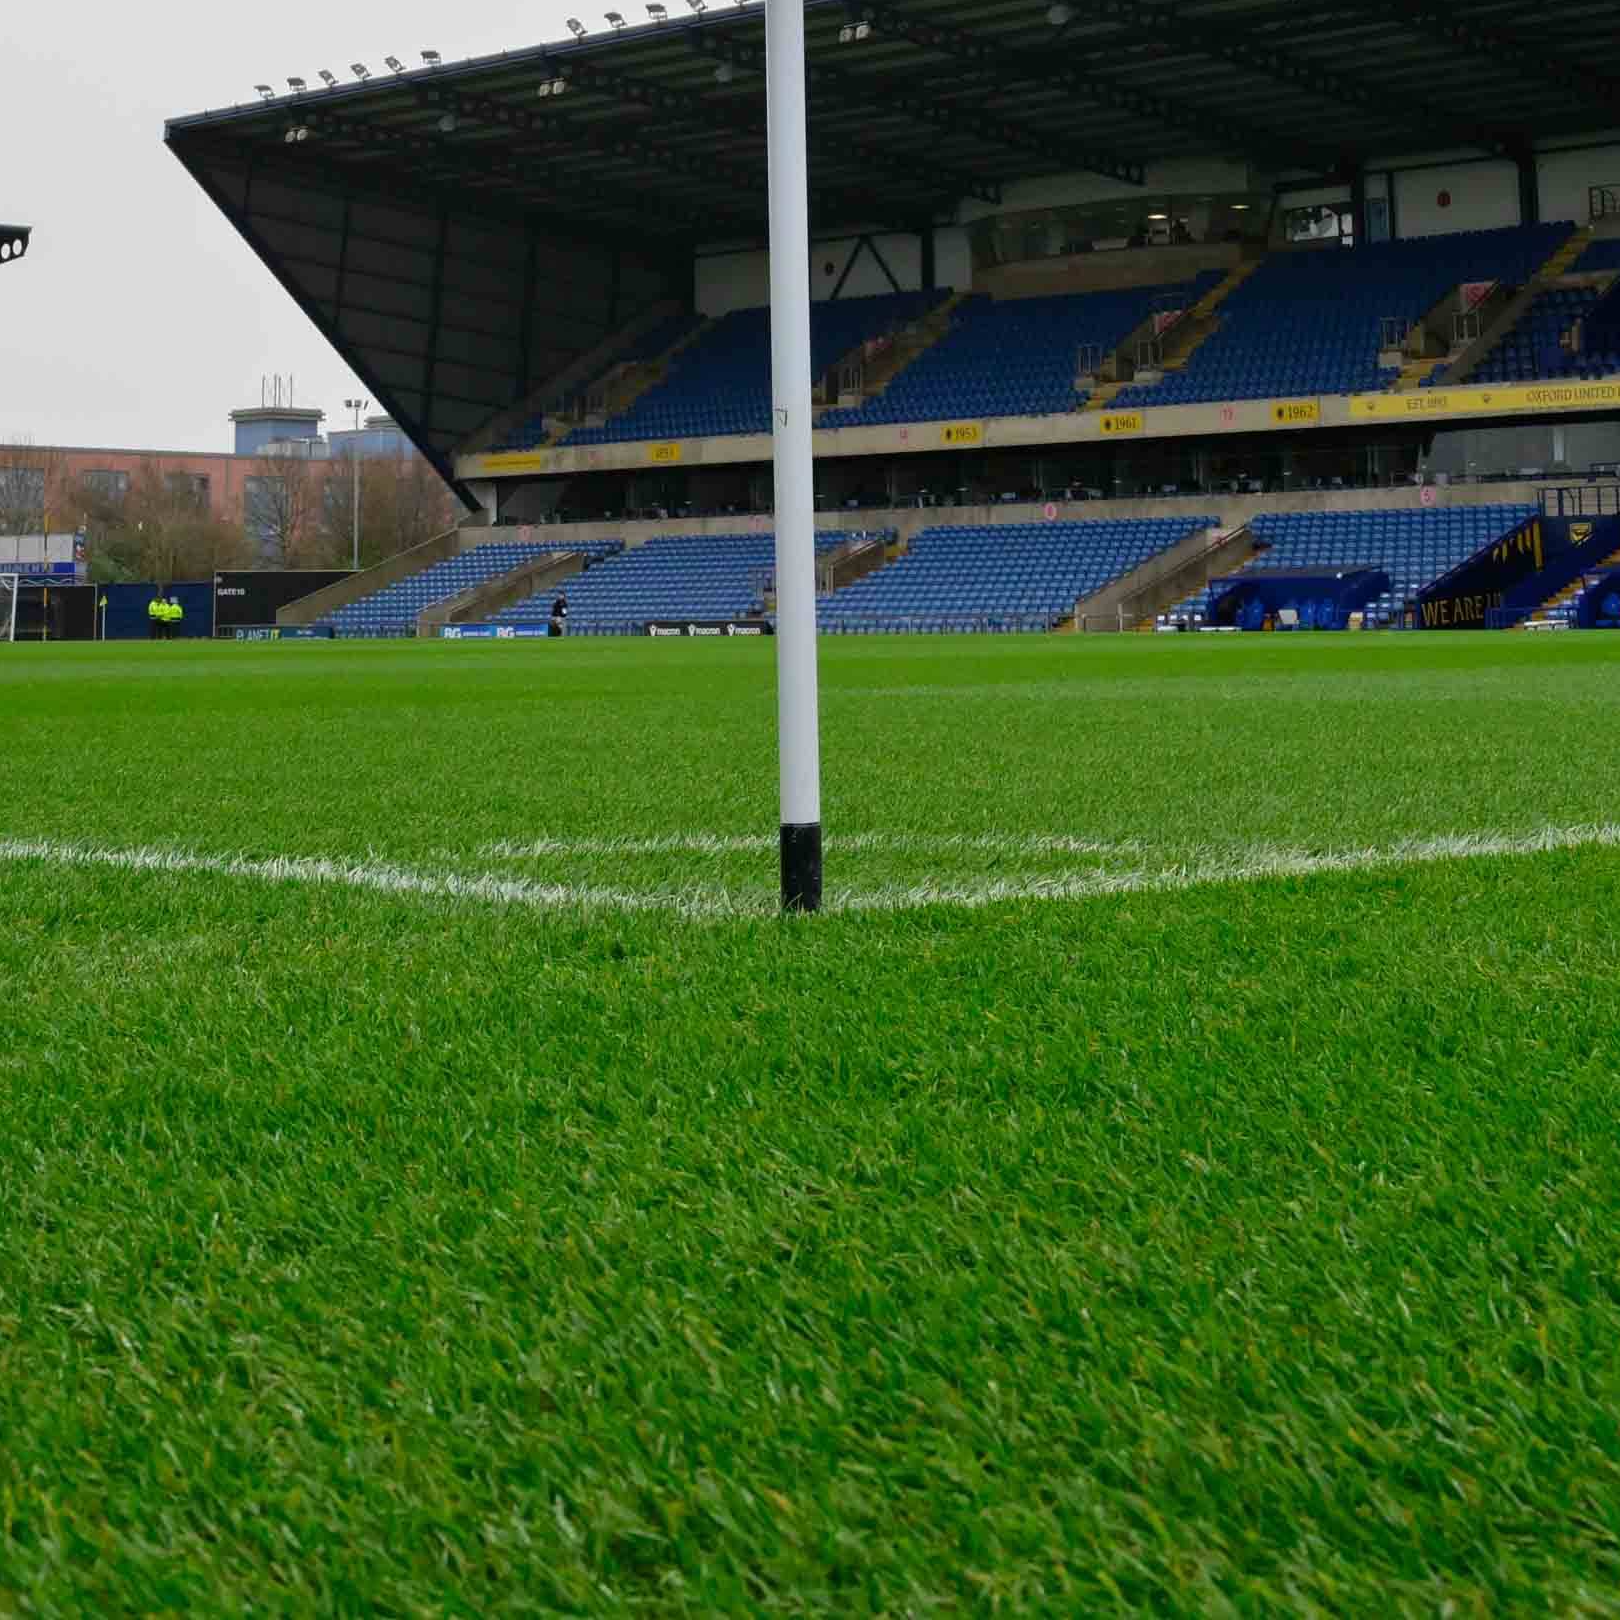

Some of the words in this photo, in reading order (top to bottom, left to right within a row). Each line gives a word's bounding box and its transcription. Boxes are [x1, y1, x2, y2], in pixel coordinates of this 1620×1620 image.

[1573, 386, 1614, 400] UNITED
[1420, 598, 1452, 628] WE
[1452, 595, 1485, 623] ARE
[695, 627, 721, 635] macron
[734, 627, 761, 635] macron
